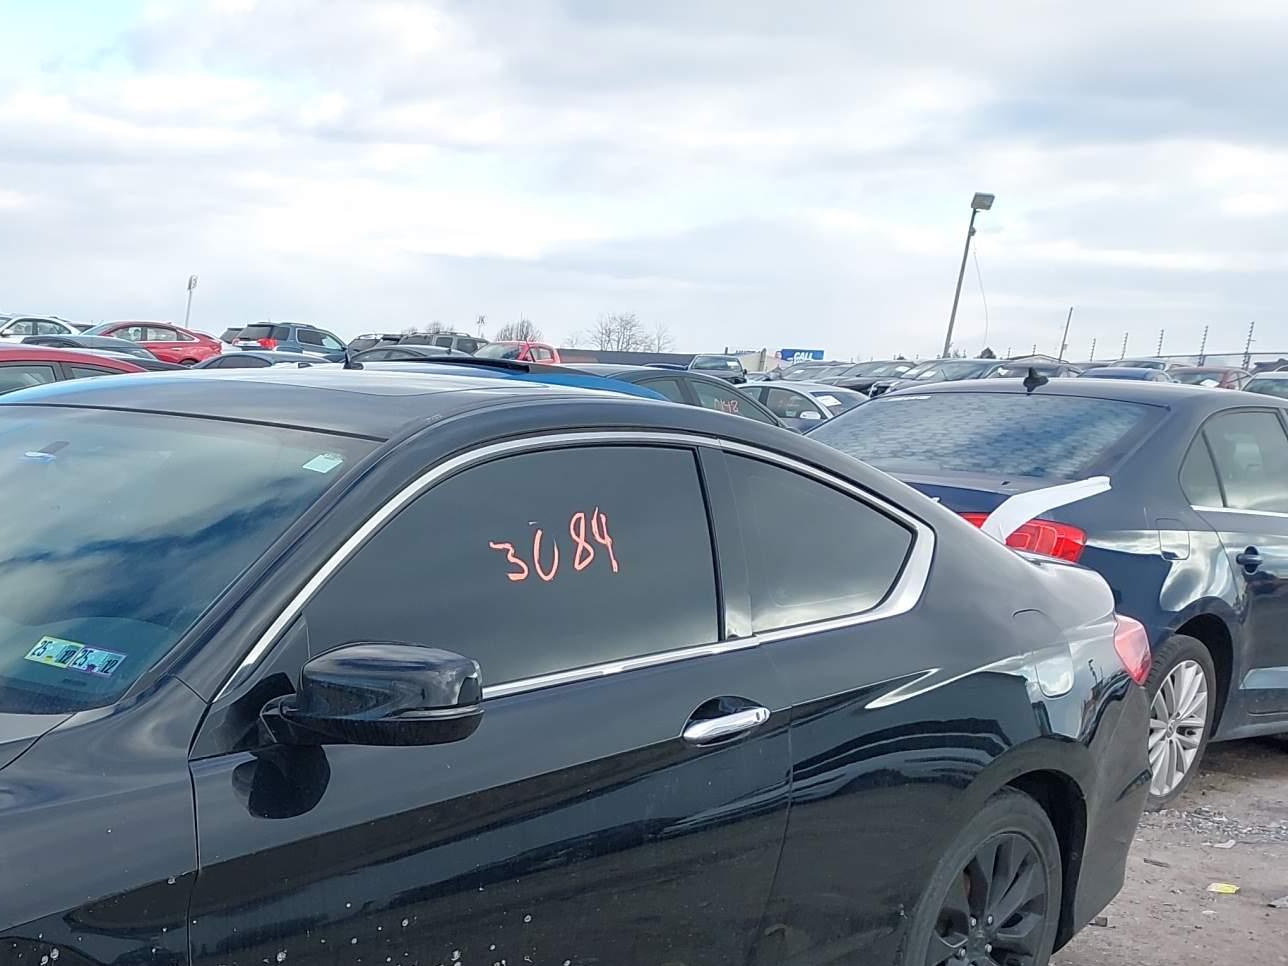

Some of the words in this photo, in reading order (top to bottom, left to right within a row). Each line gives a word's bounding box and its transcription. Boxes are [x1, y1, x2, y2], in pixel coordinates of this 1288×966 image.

[488, 506, 619, 582] 3084
[32, 640, 53, 657] 25
[72, 649, 94, 667] 25
[100, 659, 119, 674] 12
